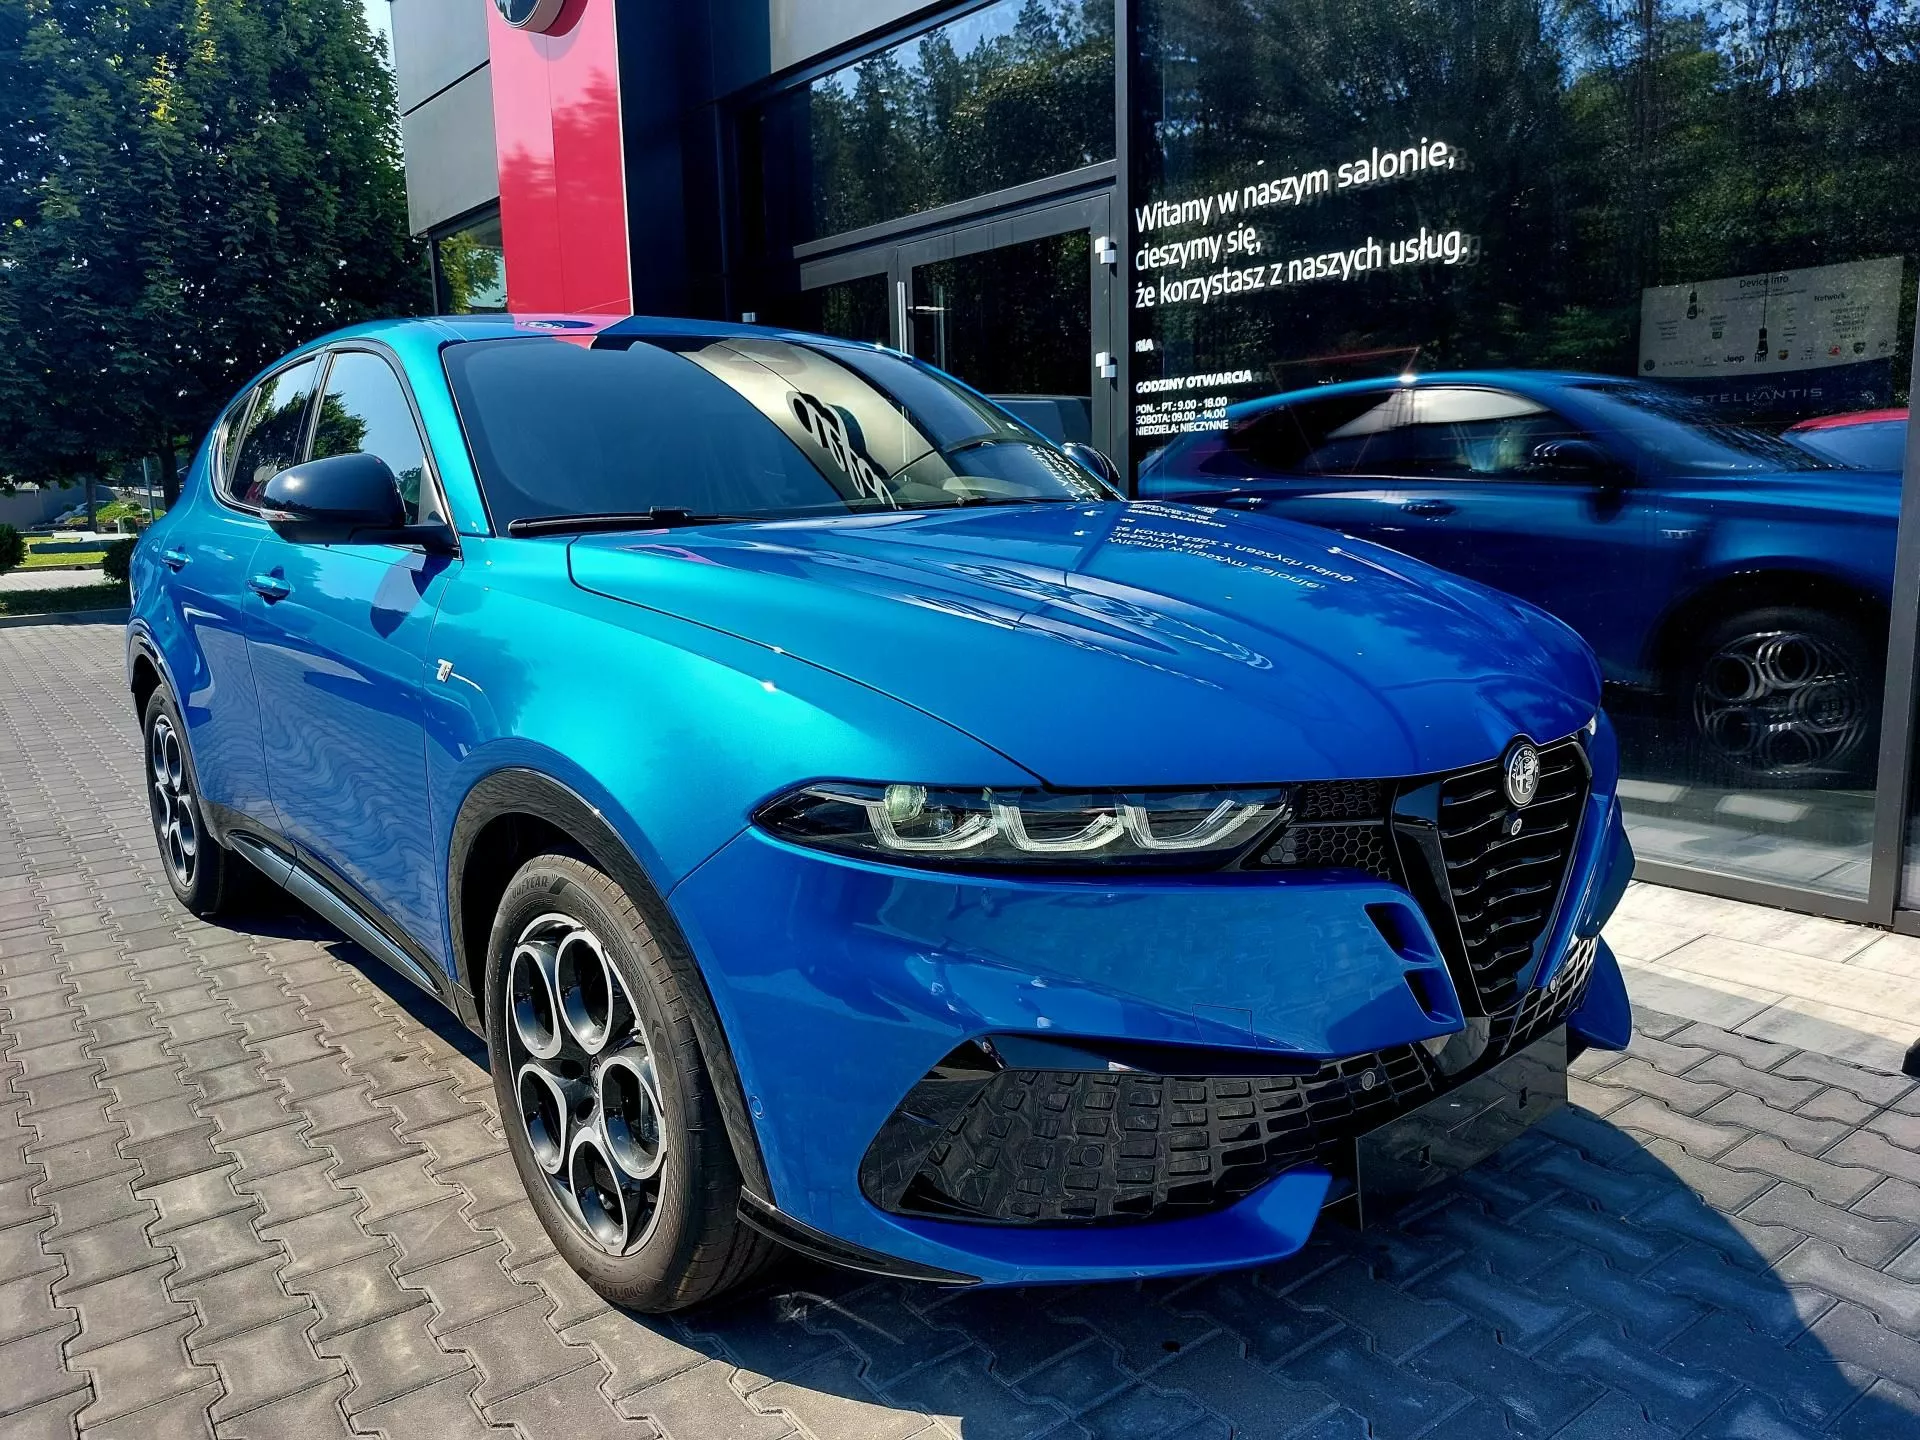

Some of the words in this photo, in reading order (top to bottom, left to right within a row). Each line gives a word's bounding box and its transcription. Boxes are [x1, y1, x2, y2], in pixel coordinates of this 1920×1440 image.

[1135, 195, 1214, 233] Witamy
[1217, 190, 1239, 215] w
[1243, 168, 1329, 209] naszym
[1337, 137, 1455, 188] salonie,
[1135, 233, 1223, 271] cieszymy
[1226, 222, 1262, 256] się,
[1135, 281, 1156, 309] że
[1160, 265, 1266, 305] korzystasz
[1269, 263, 1283, 286] z
[1288, 236, 1382, 282] naszych
[1389, 226, 1468, 265] usług.
[1135, 377, 1185, 394] GODZINY
[1185, 369, 1253, 389] OTWARCIA
[1135, 402, 1156, 414] PON.
[1177, 399, 1197, 411] 9.00
[1203, 396, 1228, 408] 18.00
[1693, 387, 1823, 405] STELLANTIS
[1135, 412, 1171, 425] SOBOTA:
[1171, 411, 1196, 422] 09.00
[1203, 407, 1227, 420] 14.00
[1135, 423, 1179, 436] NIEDZIELA:
[1180, 419, 1229, 433] NIECZYNNE
